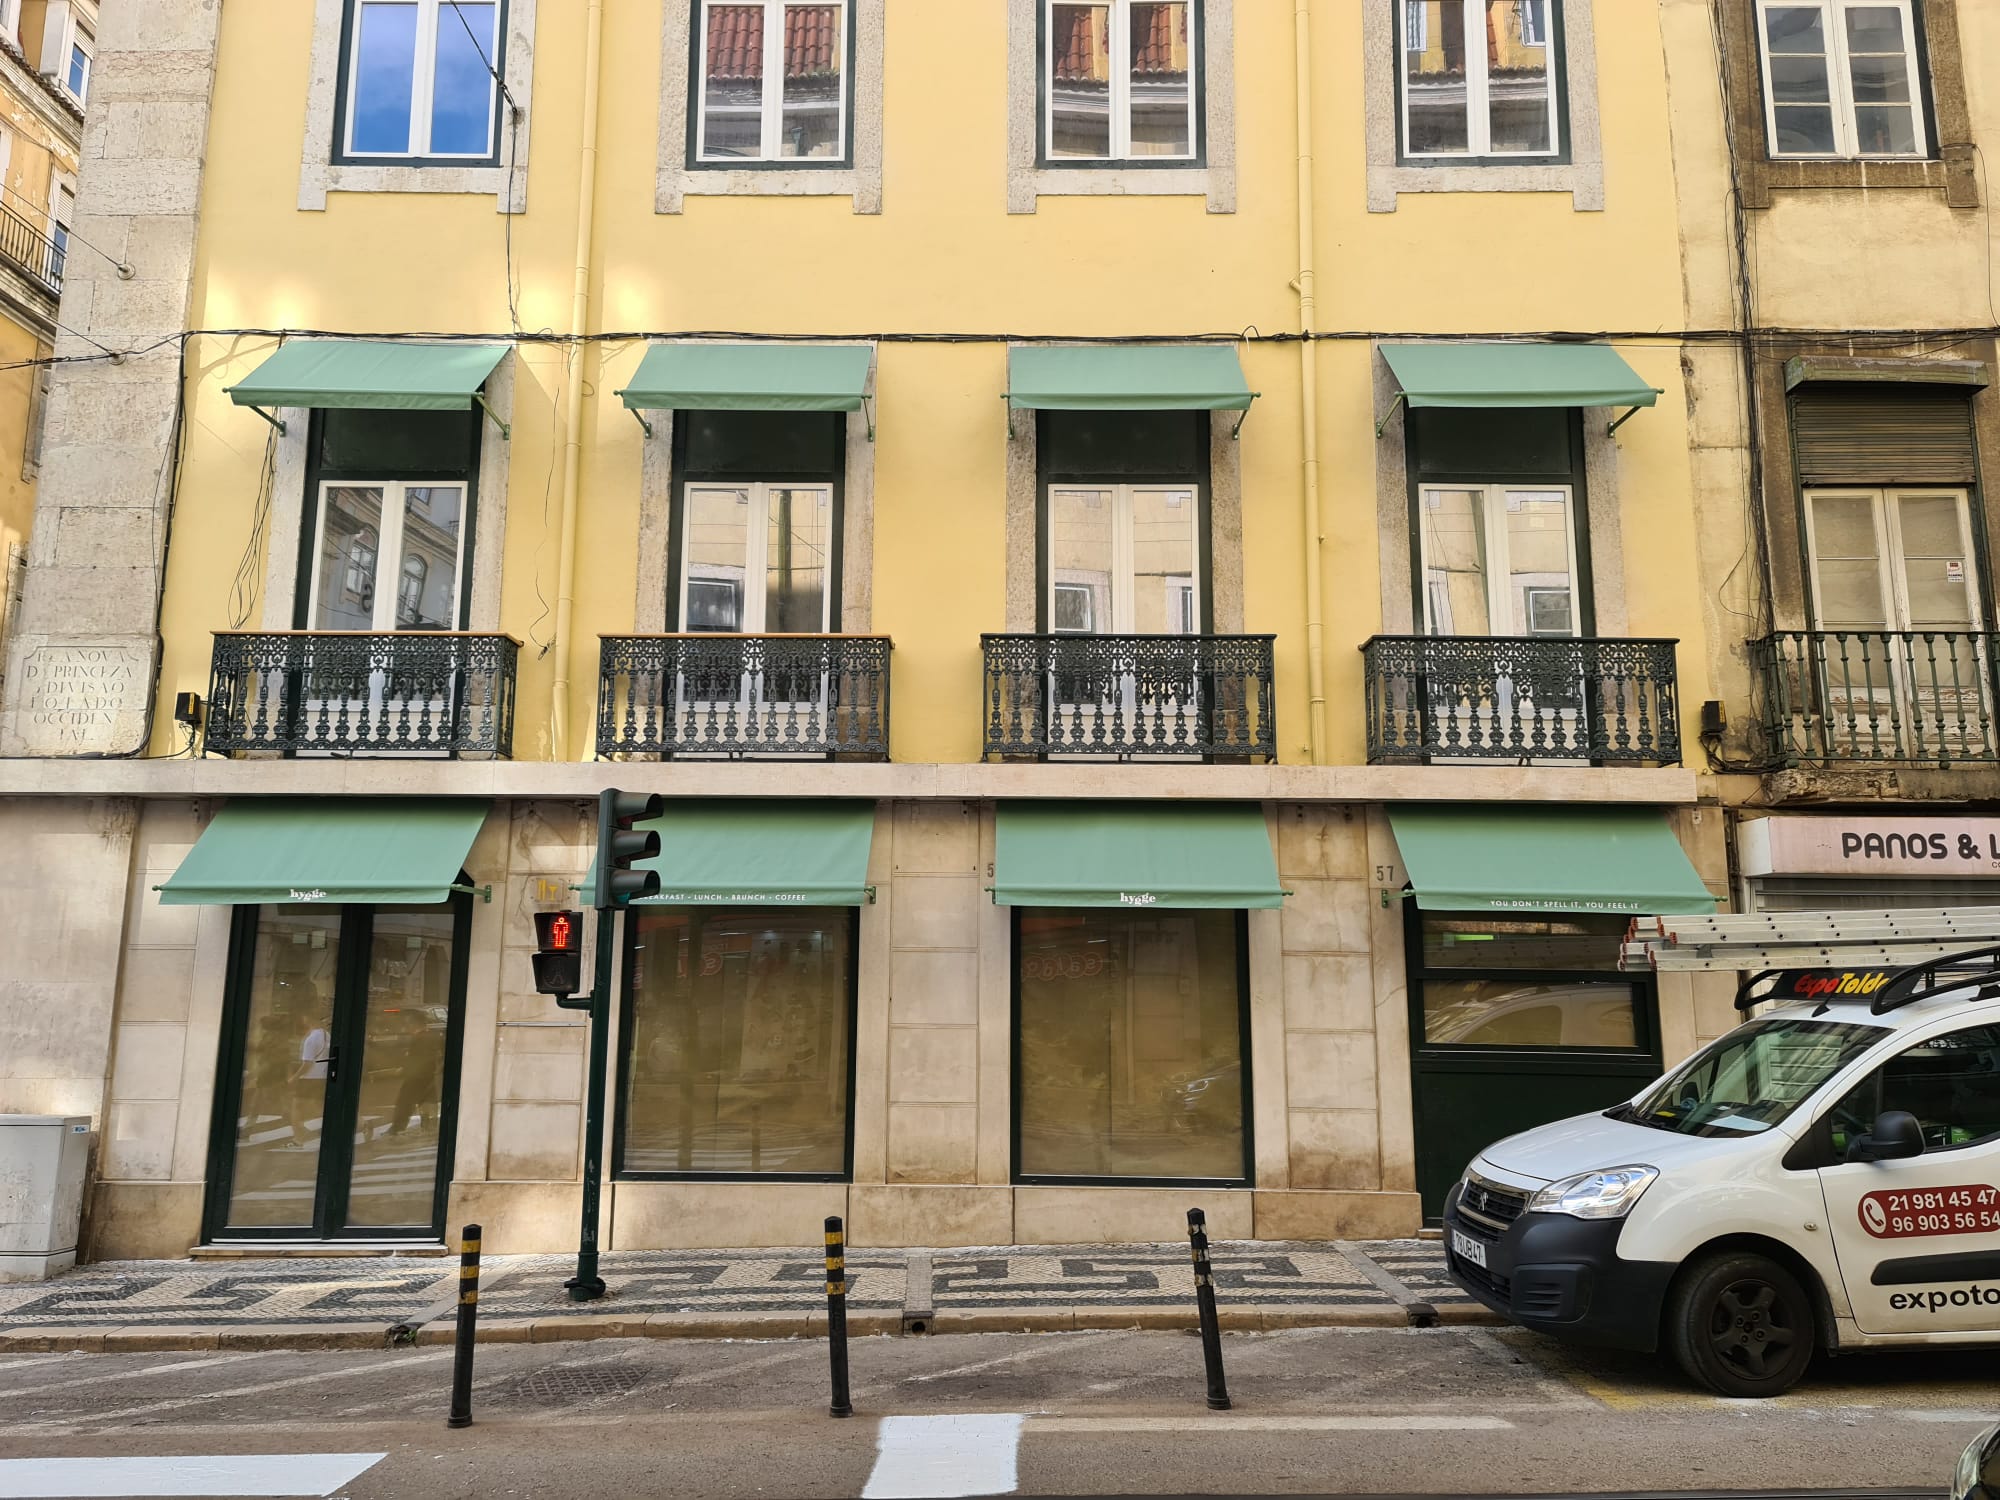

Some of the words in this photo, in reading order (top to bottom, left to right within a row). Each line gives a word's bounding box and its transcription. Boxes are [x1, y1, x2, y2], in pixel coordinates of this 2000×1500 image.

[1842, 832, 1948, 859] PANOS
[1957, 833, 1982, 859] &
[1376, 865, 1394, 881] 57
[290, 888, 328, 902] hygge
[1120, 892, 1156, 905] hygge
[1512, 900, 1540, 908] DON'T
[1888, 1195, 1909, 1211] 21
[1912, 1192, 1945, 1210] 981
[1948, 1190, 1972, 1207] 45
[1976, 1189, 1997, 1205] 47
[1892, 1216, 1914, 1232] 96
[1918, 1214, 1950, 1231] 903
[1954, 1212, 1976, 1229] 56
[1980, 1210, 2000, 1227] 54
[1889, 1284, 2000, 1313] expoto
